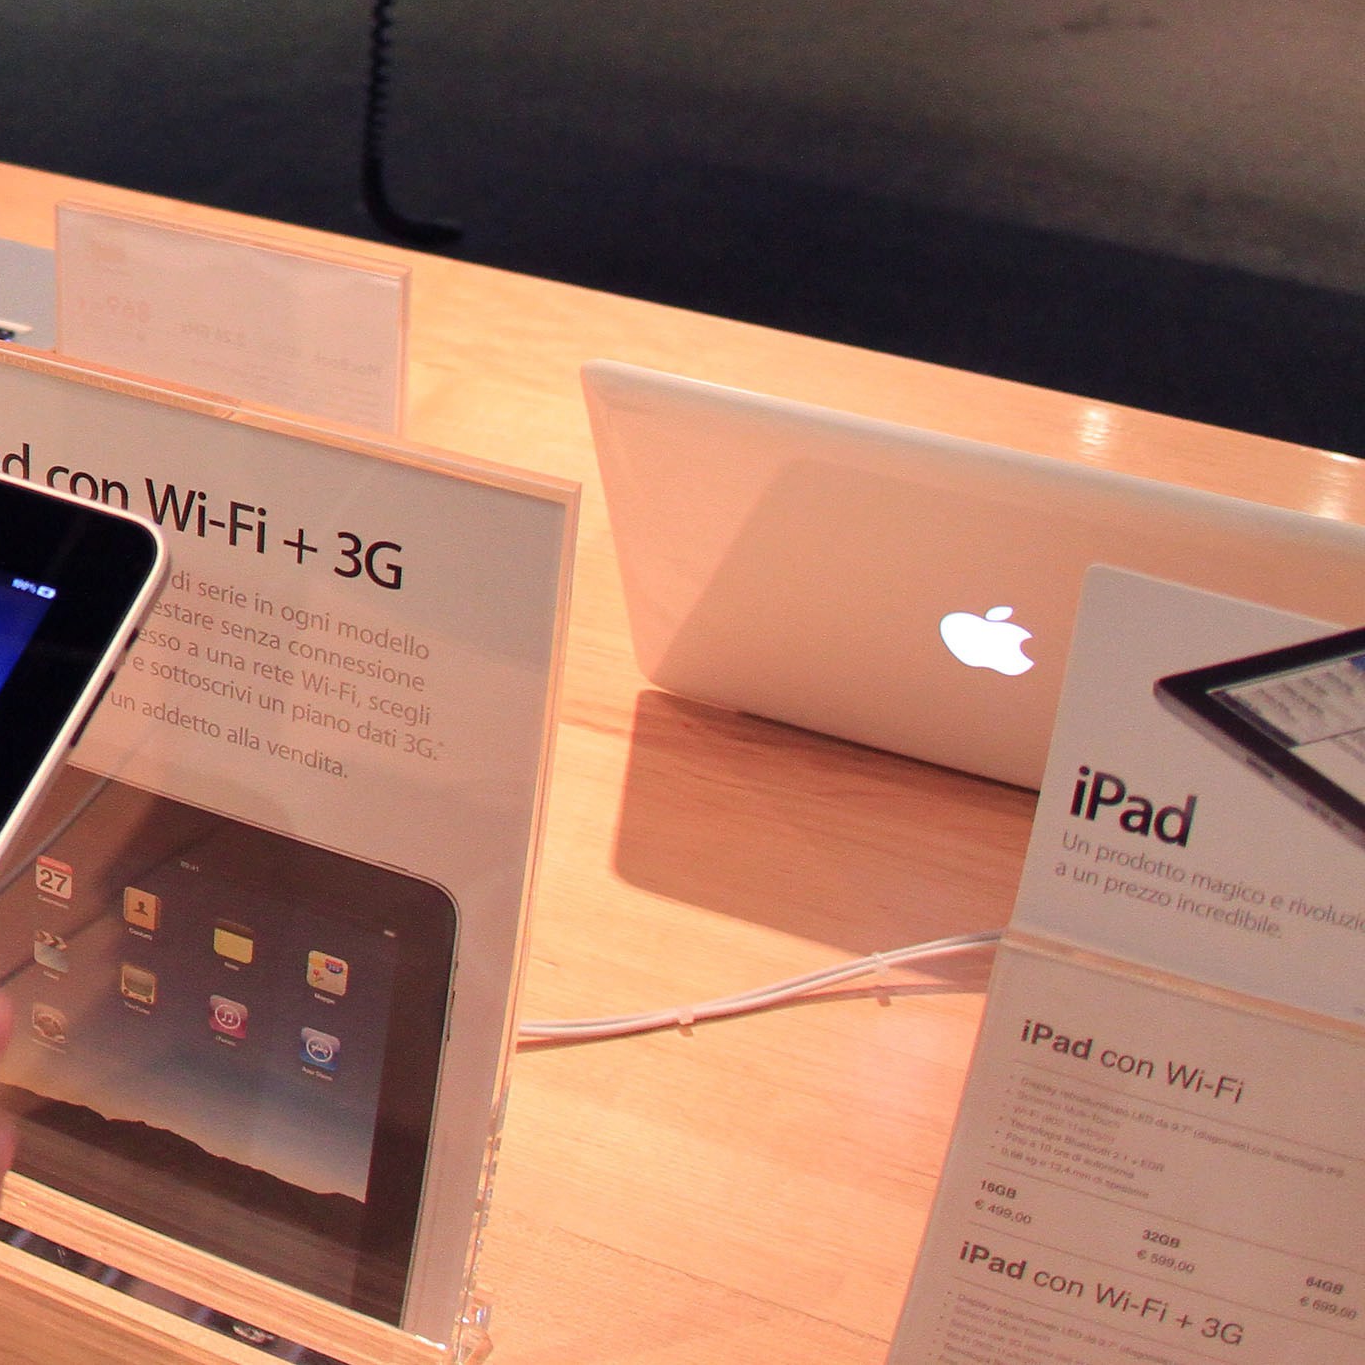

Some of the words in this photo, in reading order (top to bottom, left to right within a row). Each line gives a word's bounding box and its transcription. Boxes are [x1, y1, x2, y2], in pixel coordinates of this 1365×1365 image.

[46, 465, 129, 510] con
[145, 478, 268, 555] Wi-Fi
[282, 527, 319, 565] +
[333, 531, 405, 591] 3G
[153, 599, 214, 631] estare
[221, 619, 281, 650] senza
[288, 638, 426, 692] connessione
[172, 570, 190, 592] di
[198, 580, 247, 609] serie
[254, 593, 273, 617] in
[281, 607, 330, 632] ogni
[337, 620, 430, 661] modello
[132, 655, 145, 671] e
[150, 658, 252, 705] sottoscrivi
[258, 694, 285, 715] un
[292, 703, 351, 734] piano
[357, 721, 396, 748] dati
[138, 626, 181, 652] esso
[188, 641, 199, 657] a
[206, 648, 245, 672] una
[253, 659, 294, 684] rete
[301, 669, 361, 709] Wi-Fi,
[369, 694, 431, 726] scegli
[110, 690, 136, 712] un
[142, 700, 221, 739] addetto
[227, 726, 260, 751] alla
[267, 738, 349, 779] vendita.
[1069, 765, 1198, 848] iPad
[39, 868, 68, 892] 27
[1055, 862, 1067, 876] a
[1073, 867, 1099, 886] un
[1103, 875, 1172, 907] prezzo
[1176, 893, 1282, 939] incredibile.
[1061, 831, 1090, 855] Un
[1095, 845, 1186, 883] prodotto
[1191, 871, 1266, 905] magico
[1270, 894, 1284, 910] e
[1020, 1019, 1094, 1060] iPad
[1100, 1050, 1155, 1079] con
[1166, 1061, 1245, 1104] Wi-Fi
[975, 1199, 985, 1210] €
[987, 1205, 1032, 1224] 499,00
[980, 1180, 1017, 1199] 16GB
[1137, 1249, 1147, 1260] €
[1142, 1229, 1181, 1249] 32GB
[959, 1241, 1027, 1281] iPad
[1033, 1269, 1084, 1298] con
[1095, 1282, 1168, 1323] Wi-Fi
[1176, 1314, 1193, 1328] +
[1201, 1317, 1244, 1346] 3G
[1306, 1277, 1344, 1295] 64GB
[1312, 1300, 1357, 1320] 699,00
